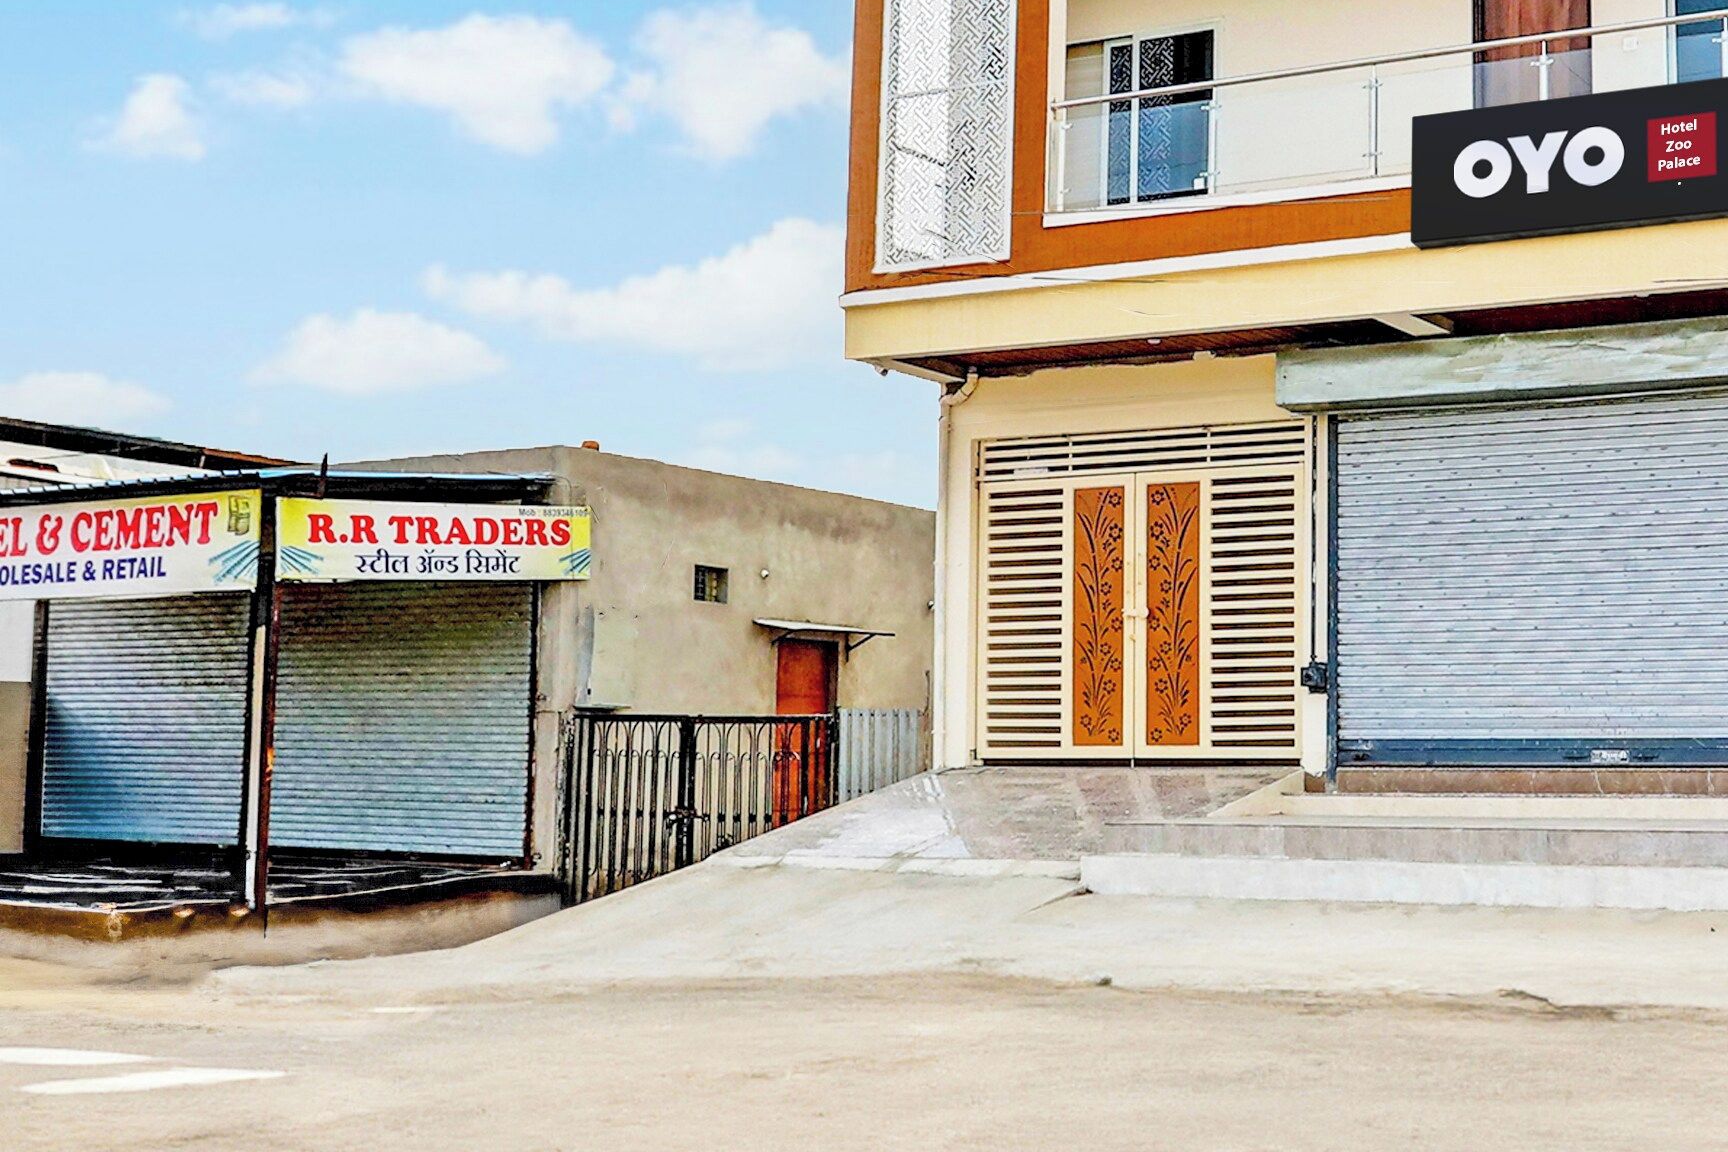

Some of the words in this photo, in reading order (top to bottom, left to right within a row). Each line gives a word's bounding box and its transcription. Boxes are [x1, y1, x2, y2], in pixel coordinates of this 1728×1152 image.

[1660, 118, 1698, 136] Hotel
[1665, 140, 1692, 153] Zoo
[1453, 126, 1625, 199] OYO
[1657, 156, 1701, 172] Palace
[36, 513, 63, 556] &
[71, 502, 218, 553] CEMENT
[307, 513, 378, 544] R.R
[388, 517, 571, 545] TRADERS
[82, 560, 96, 581] &
[102, 556, 166, 580] RETAIL
[354, 548, 410, 574] स्टील
[465, 548, 521, 574] सिमेंट
